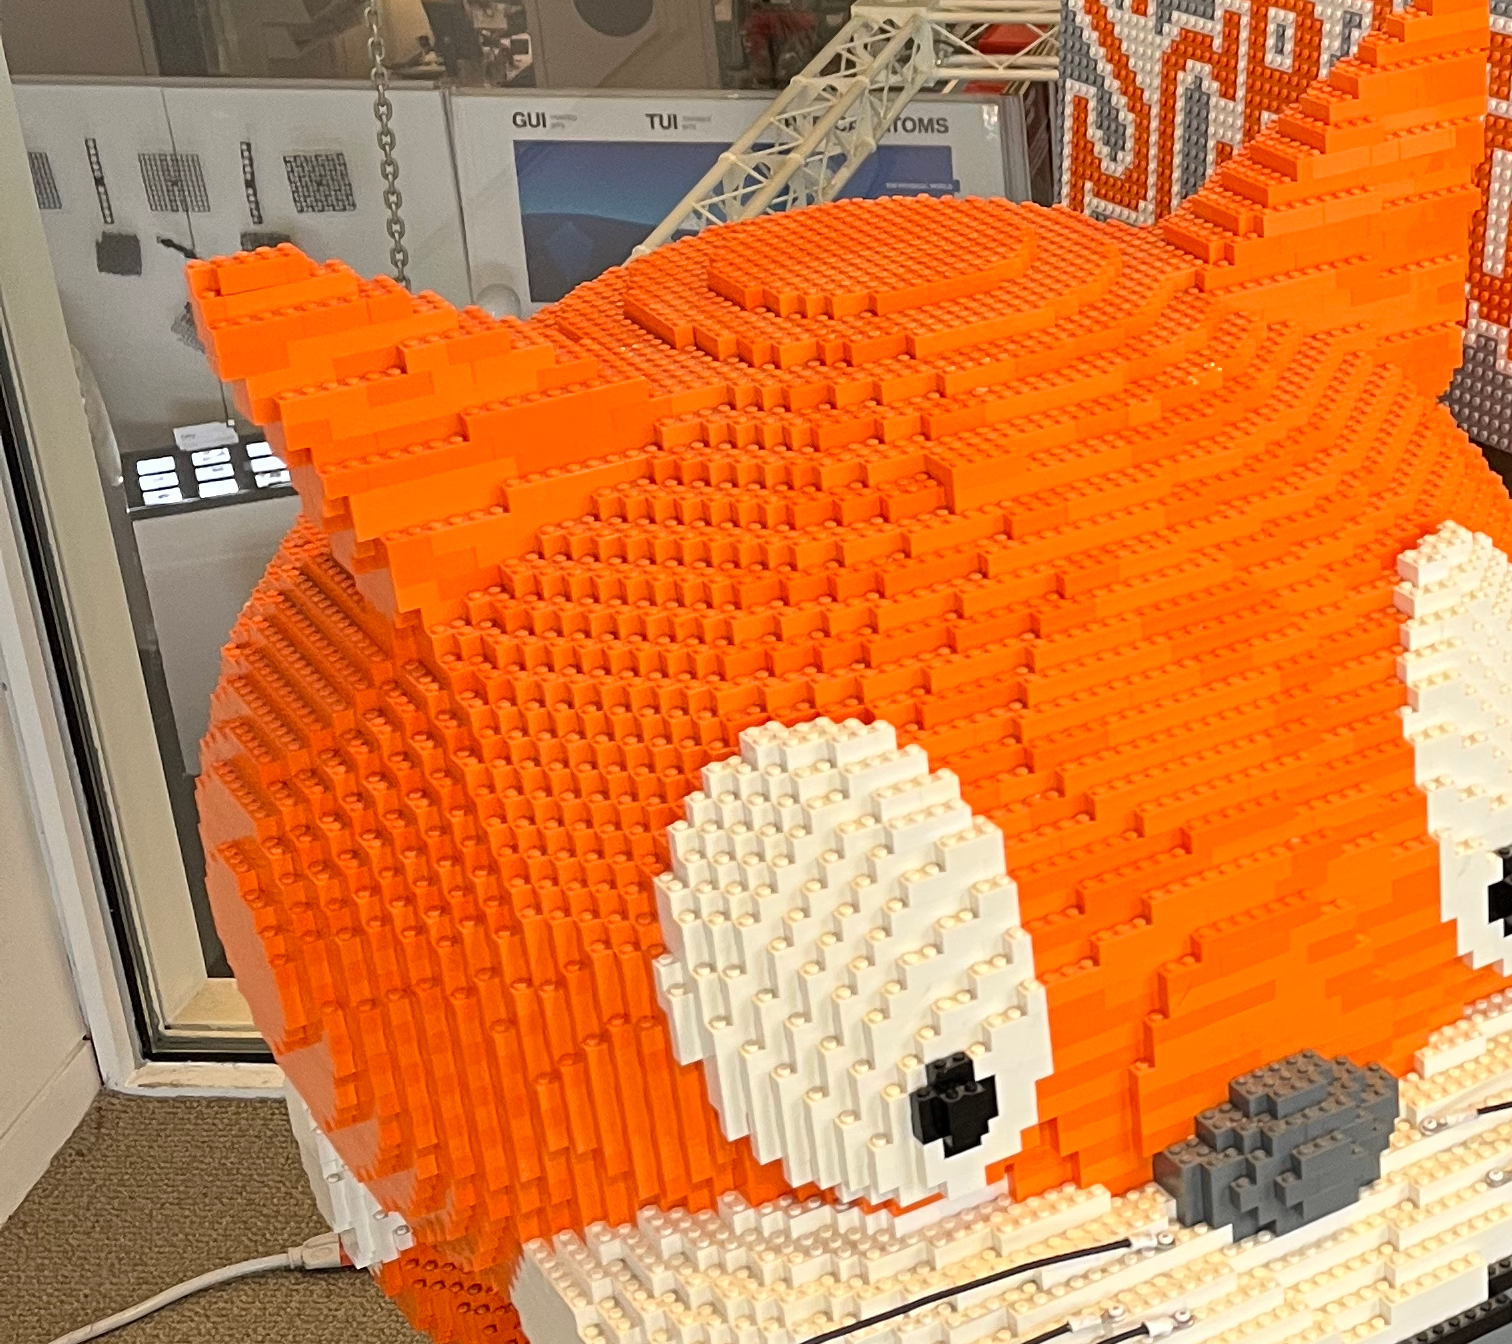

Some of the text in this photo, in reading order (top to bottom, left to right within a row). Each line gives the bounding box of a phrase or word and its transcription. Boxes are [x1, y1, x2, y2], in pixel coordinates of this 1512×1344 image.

[512, 111, 547, 129] GUI
[645, 113, 678, 130] TUI
[884, 116, 949, 134] TOMS
